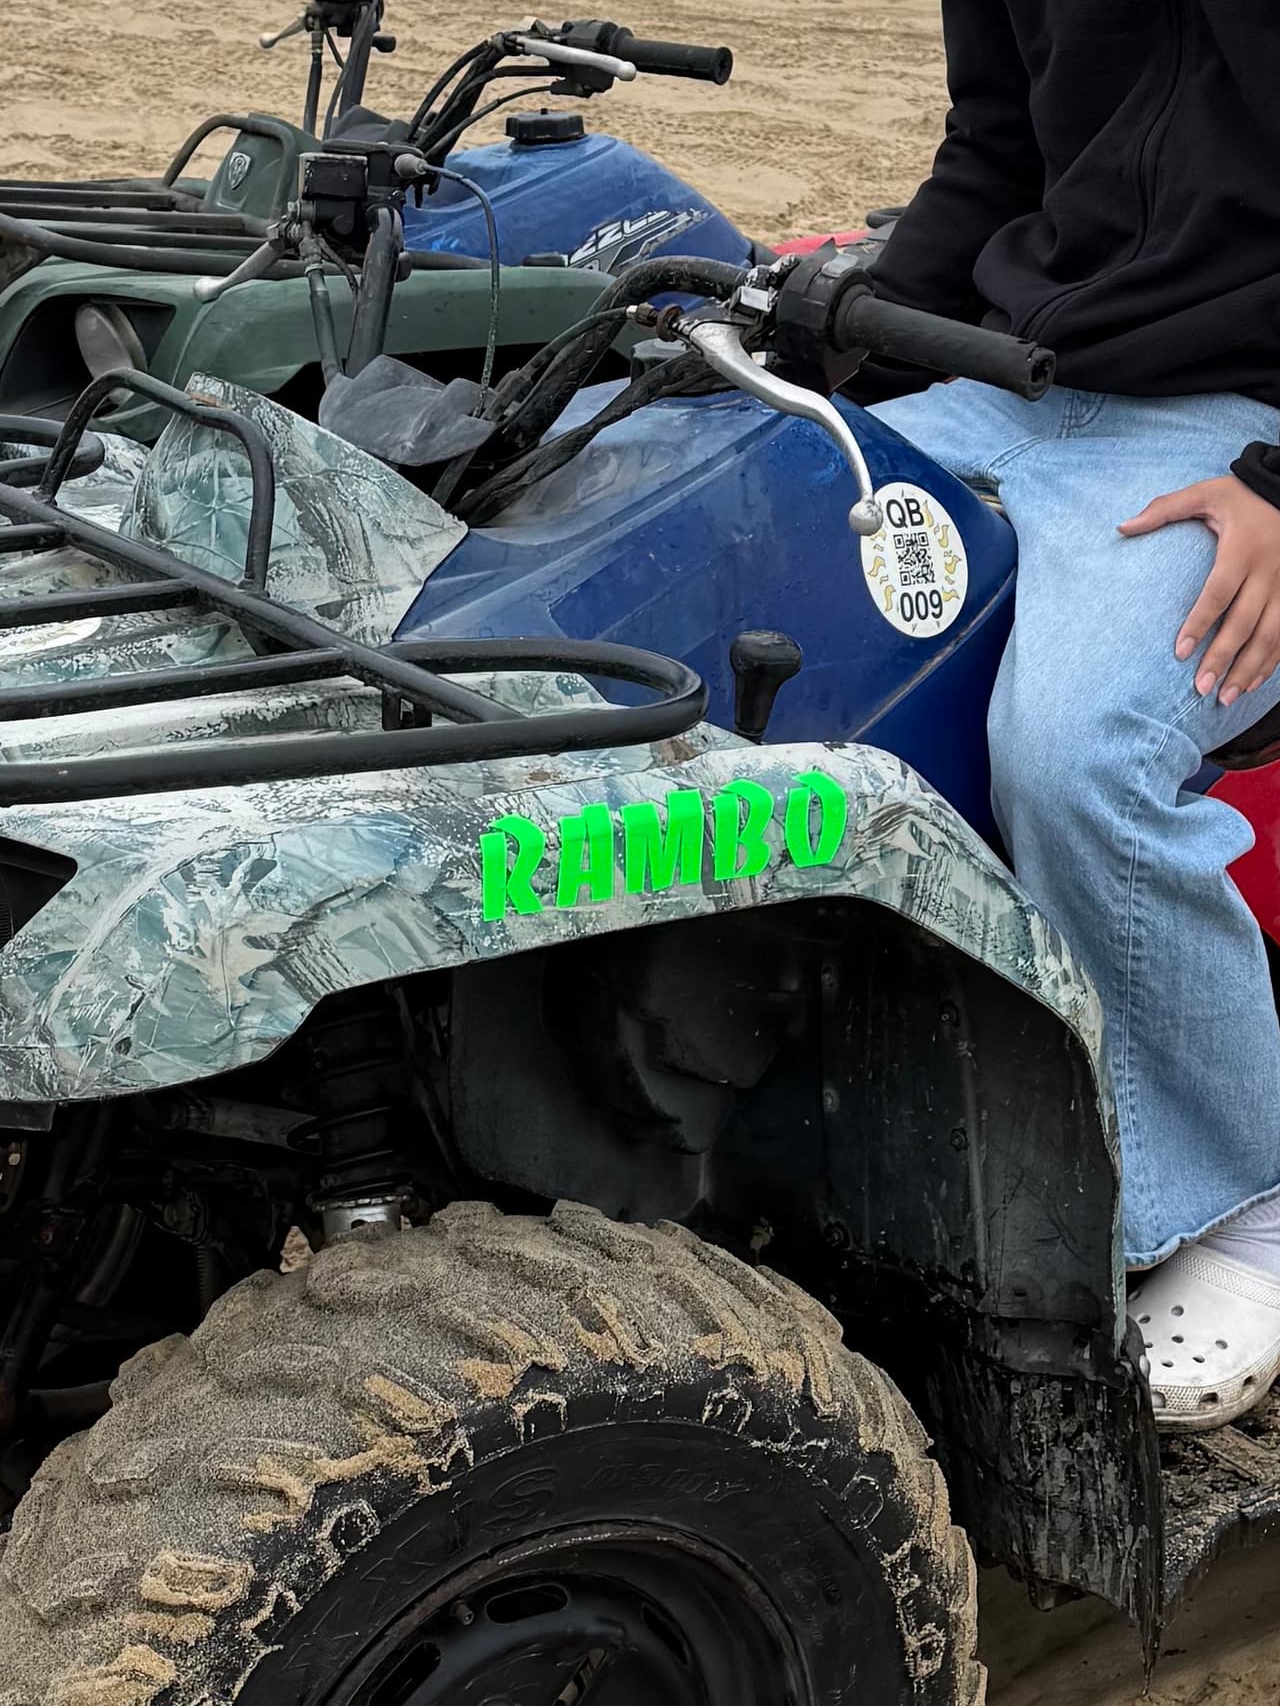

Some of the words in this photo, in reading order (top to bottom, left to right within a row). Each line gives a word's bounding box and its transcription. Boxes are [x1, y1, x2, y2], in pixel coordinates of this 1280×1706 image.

[886, 498, 925, 529] QB
[900, 589, 944, 622] 009
[479, 768, 848, 922] RAMBO
